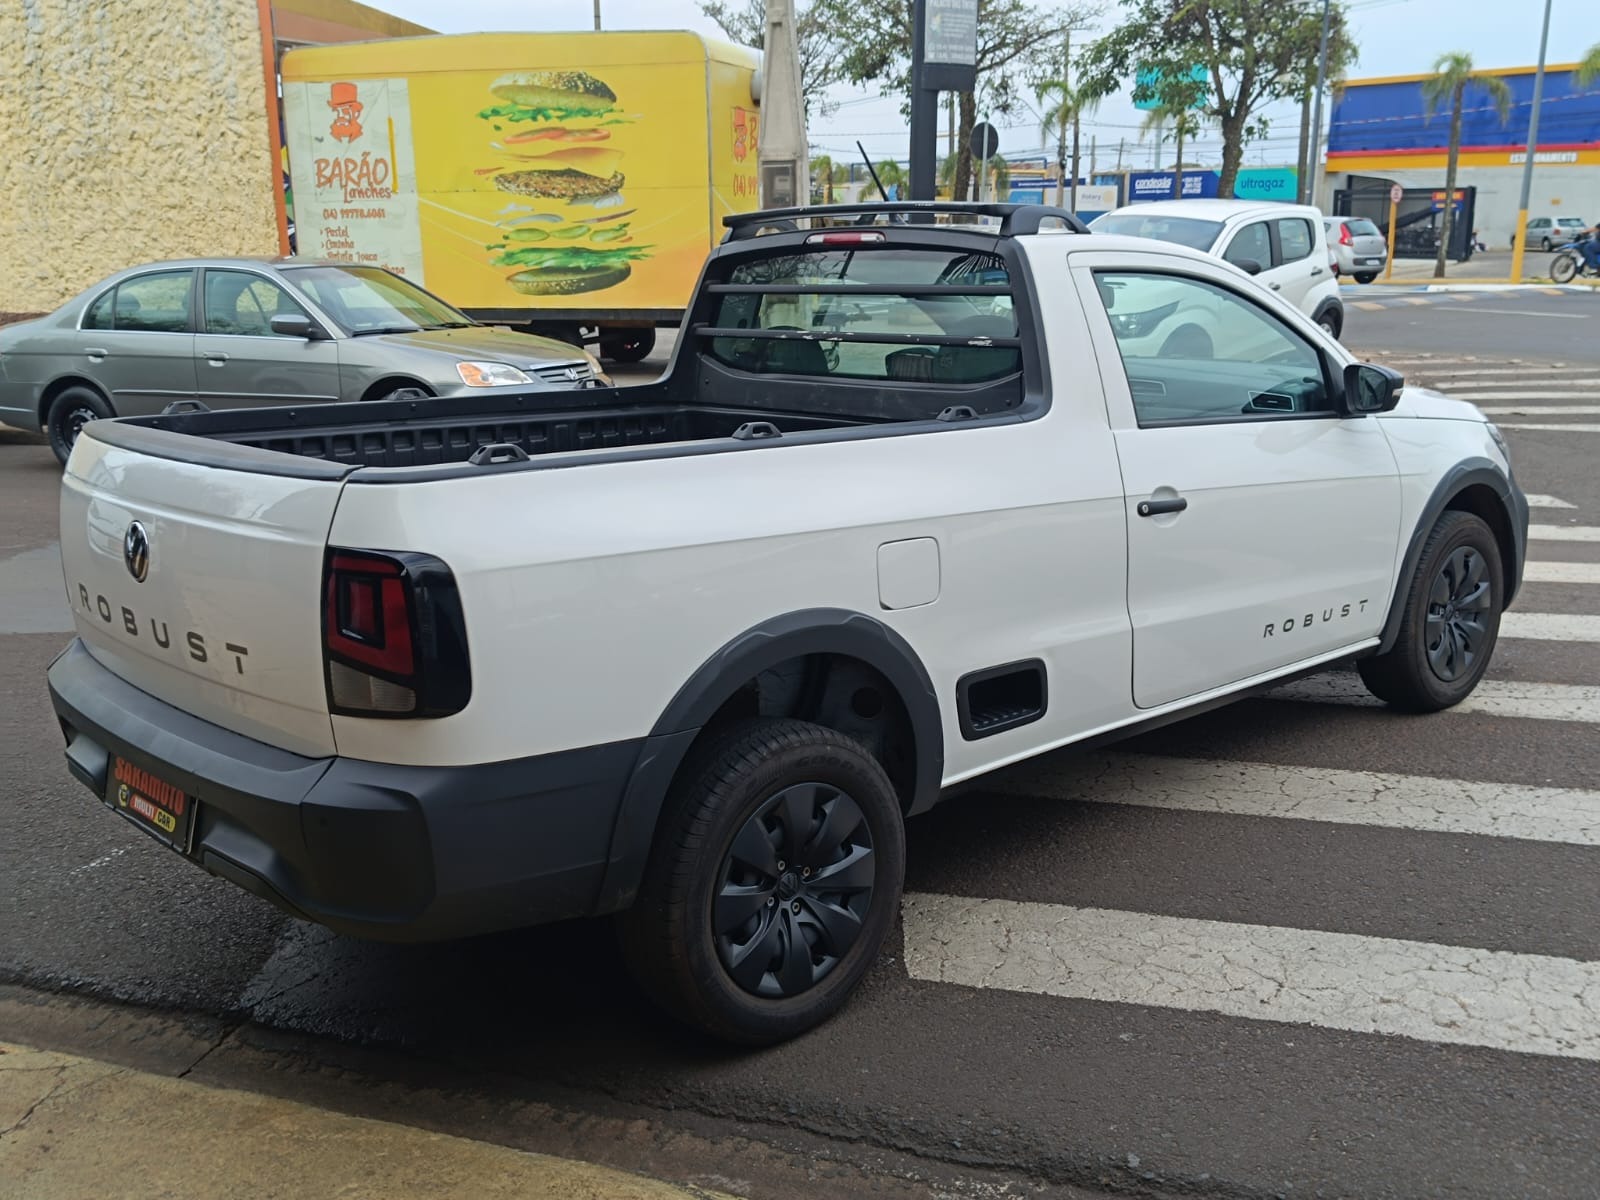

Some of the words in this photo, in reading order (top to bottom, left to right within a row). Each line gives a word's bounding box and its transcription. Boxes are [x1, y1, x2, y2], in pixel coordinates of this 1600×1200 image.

[314, 150, 389, 188] BARÃO
[344, 184, 391, 203] Lanches
[1241, 177, 1285, 192] ultragaz
[325, 226, 350, 238] Pastel
[78, 582, 248, 675] ROBUST
[1263, 599, 1368, 639] ROBUST
[157, 810, 171, 829] CAR
